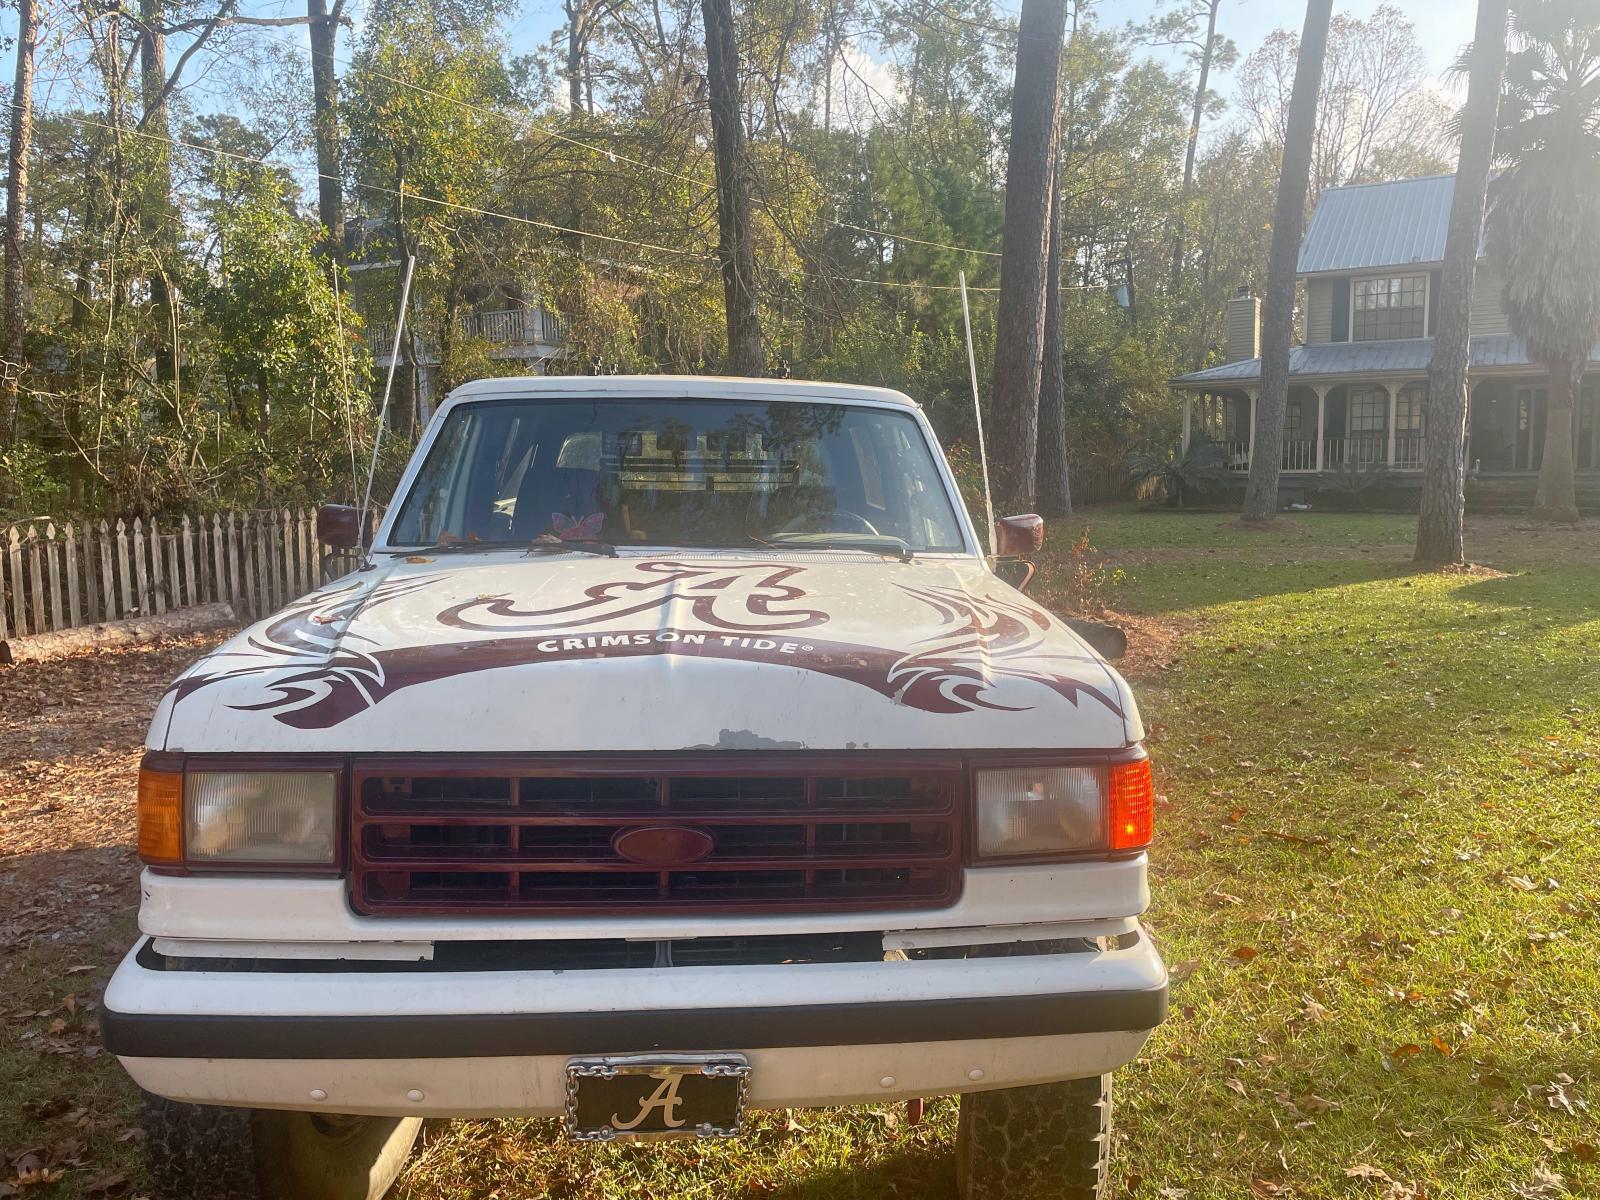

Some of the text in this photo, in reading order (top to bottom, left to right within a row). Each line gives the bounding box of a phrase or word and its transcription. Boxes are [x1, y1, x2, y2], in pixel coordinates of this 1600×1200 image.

[436, 561, 831, 631] A
[536, 631, 706, 653] CRIMSON
[611, 1073, 686, 1130] A
